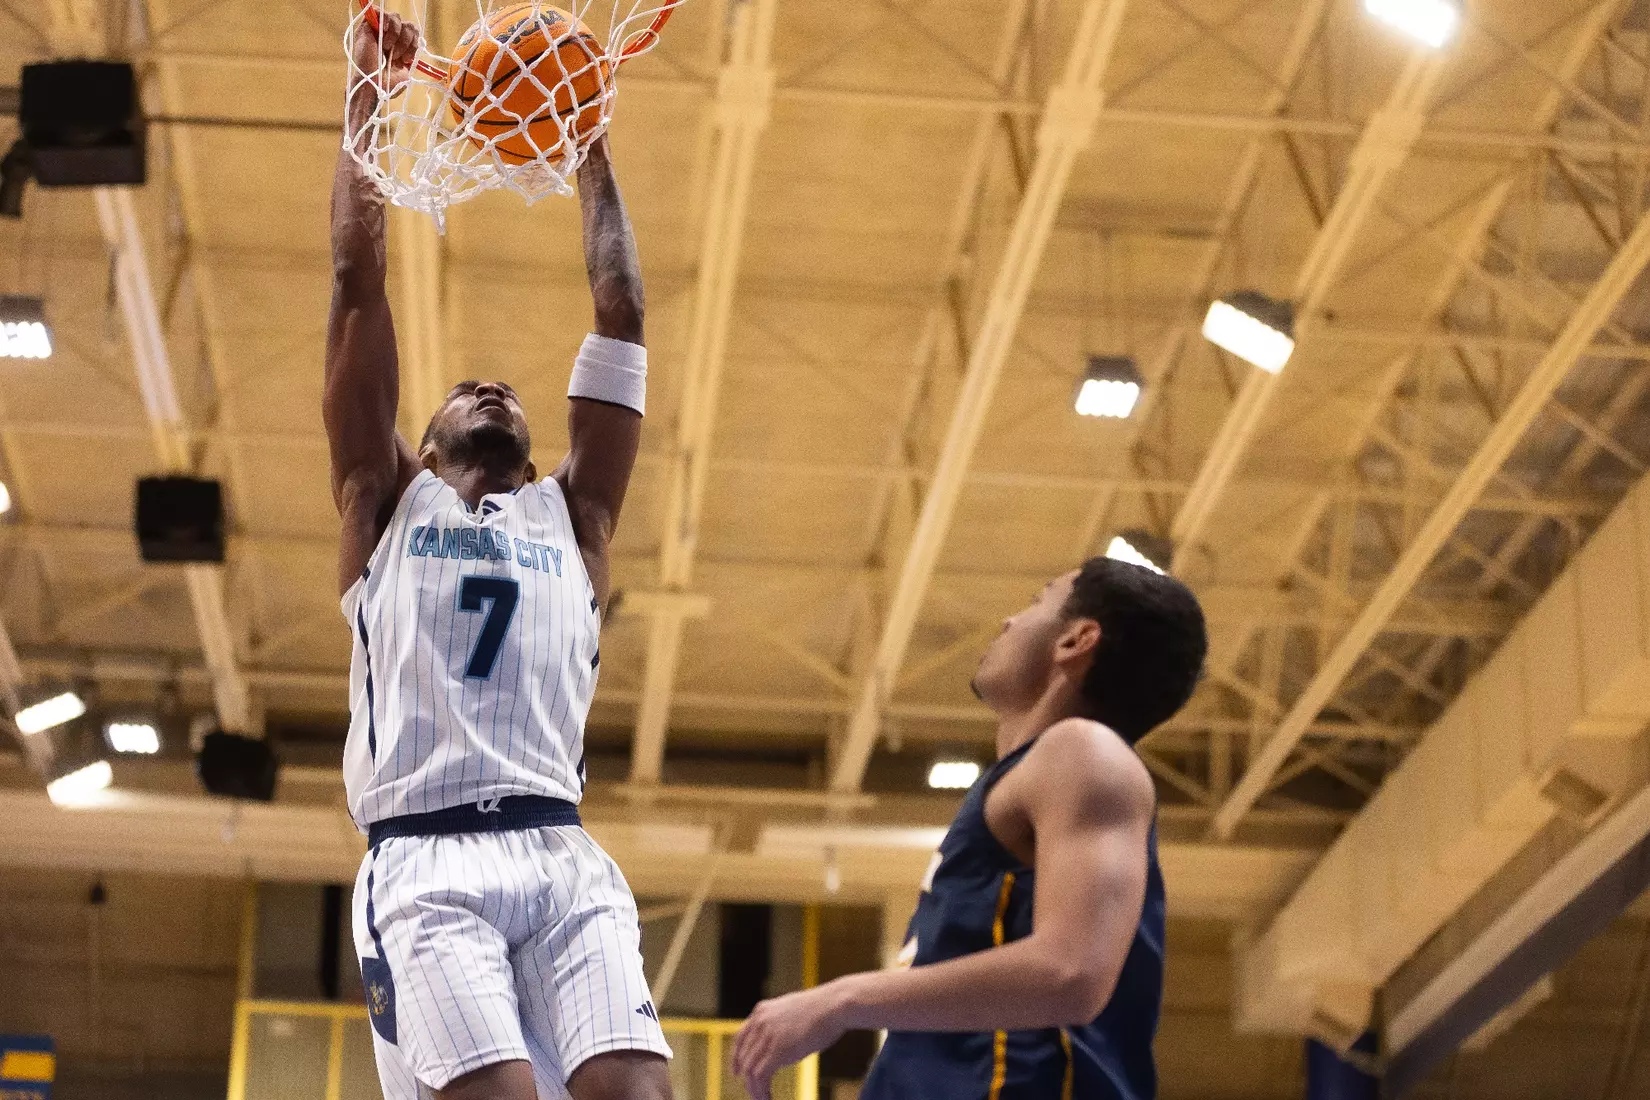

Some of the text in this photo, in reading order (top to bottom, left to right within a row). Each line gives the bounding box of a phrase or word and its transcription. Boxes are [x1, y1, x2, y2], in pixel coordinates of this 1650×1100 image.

[408, 525, 563, 577] KANSAS CITY
[458, 574, 520, 681] 7
